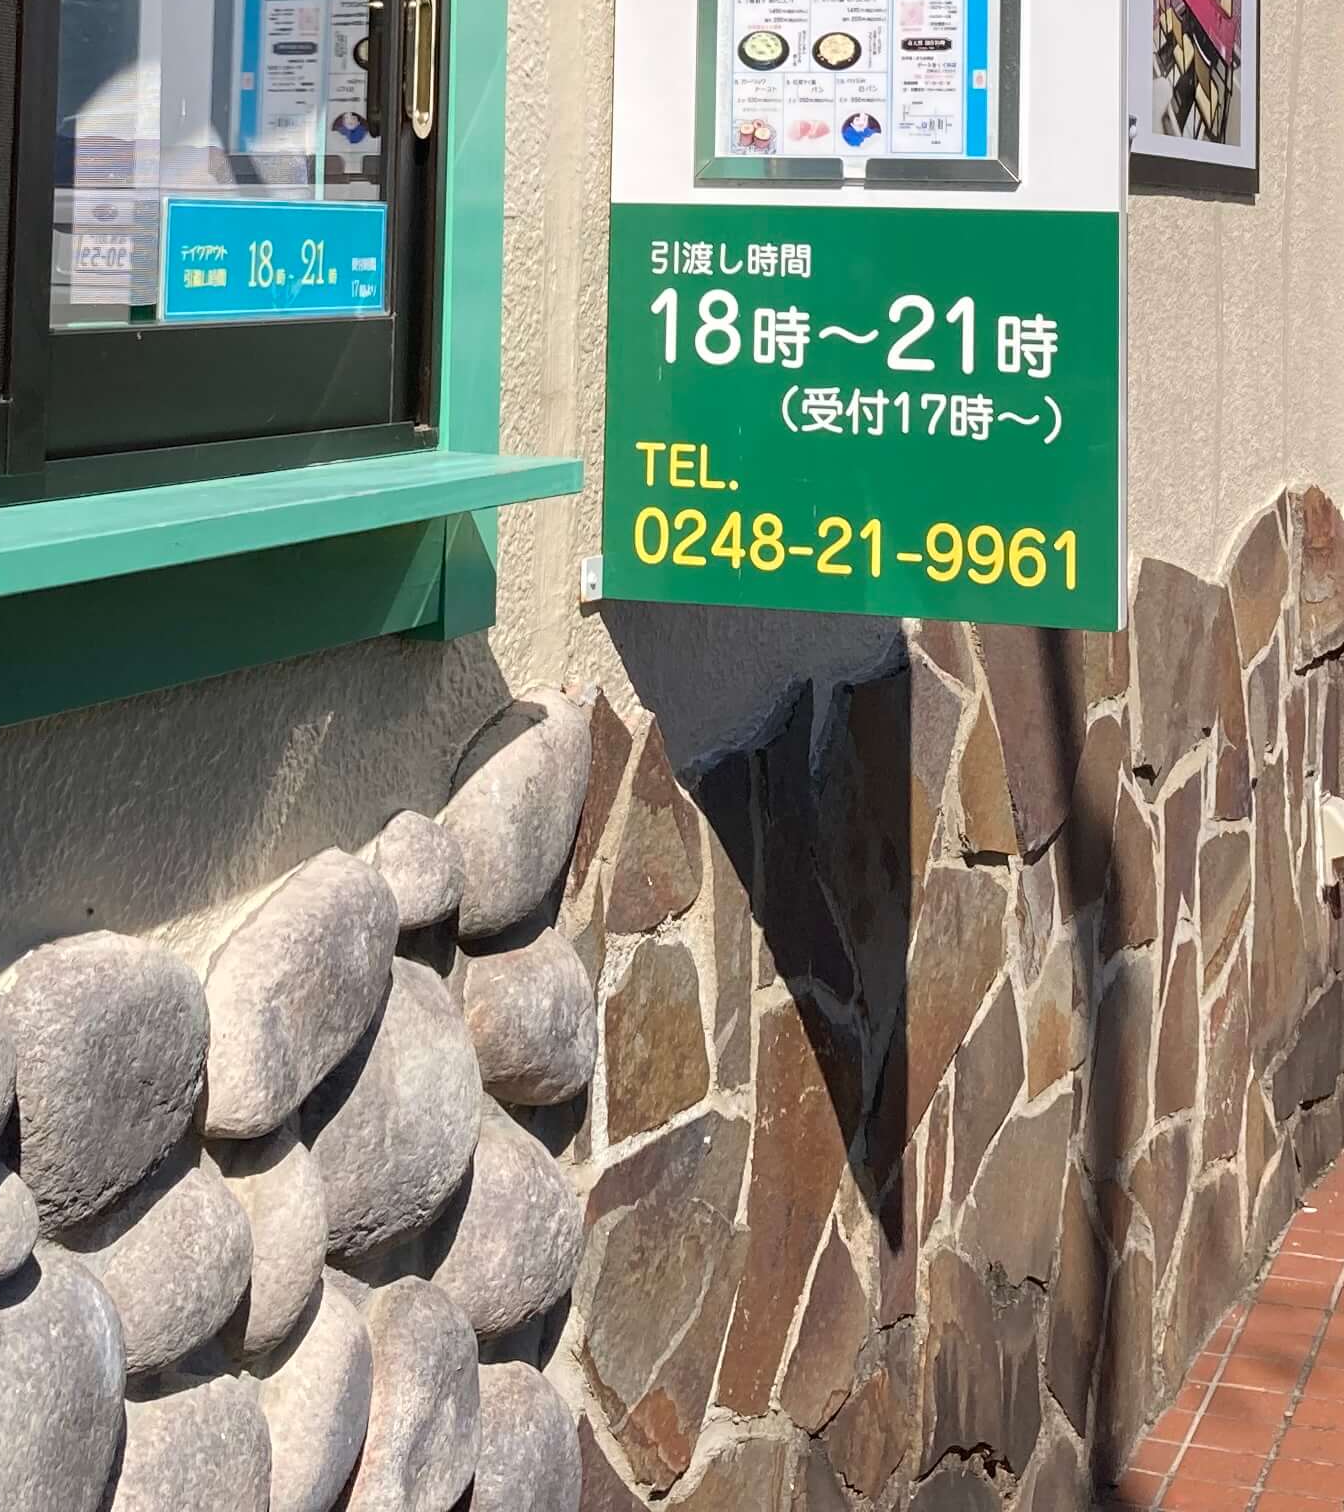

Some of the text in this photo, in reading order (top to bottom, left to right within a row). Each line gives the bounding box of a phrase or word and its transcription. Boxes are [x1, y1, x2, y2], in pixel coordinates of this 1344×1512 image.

[650, 240, 813, 279] 引渡し時間
[635, 440, 740, 491] TEL.
[633, 505, 1078, 591] 0248-21-9961
